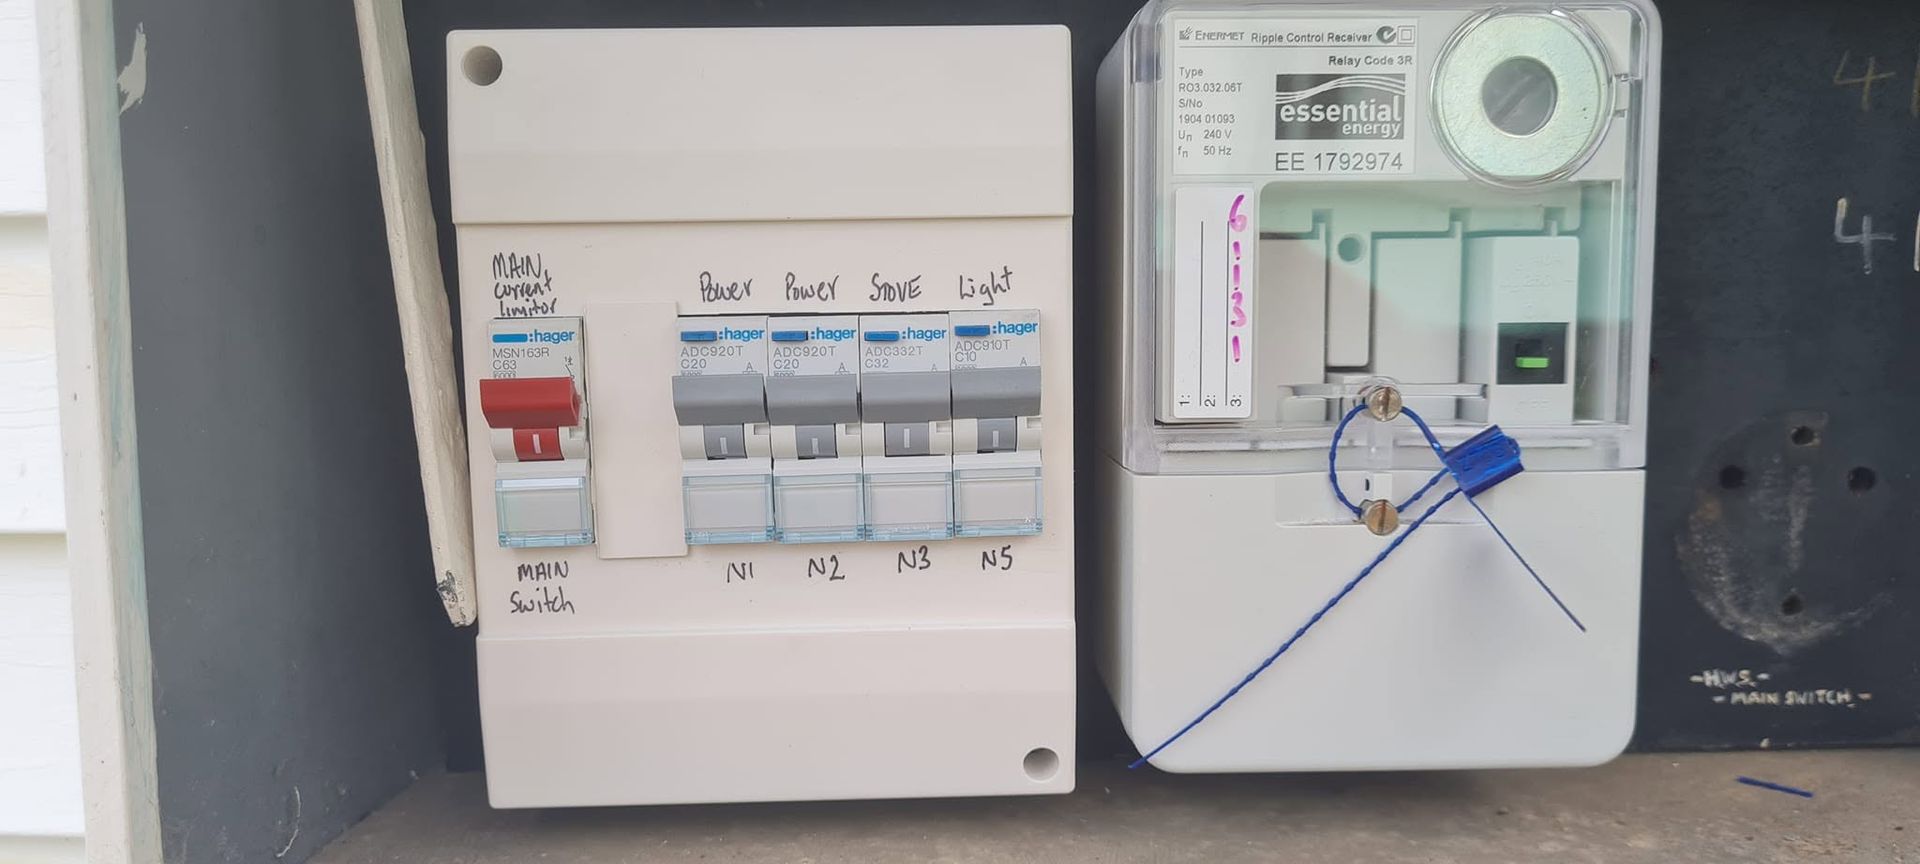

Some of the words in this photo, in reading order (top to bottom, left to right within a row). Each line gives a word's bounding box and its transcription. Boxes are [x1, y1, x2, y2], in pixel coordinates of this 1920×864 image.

[1251, 32, 1285, 43] Ripple
[1288, 32, 1324, 43] Control
[1327, 32, 1372, 43] Receiver
[1328, 55, 1361, 67] Relay
[1364, 55, 1394, 66] Code
[1397, 55, 1413, 65] 3R
[1179, 67, 1204, 78] Type
[1178, 98, 1203, 109] S/No
[1279, 95, 1402, 123] essential
[1178, 114, 1202, 124] 1904
[1204, 114, 1236, 124] 01093
[1203, 130, 1222, 140] 240
[1224, 130, 1233, 140] V
[1341, 121, 1402, 139] energy
[1203, 146, 1216, 156] 50
[1218, 147, 1232, 157] Hz
[1275, 152, 1305, 171] EE
[1313, 152, 1403, 171] 1792974
[492, 252, 541, 280] MAIN
[699, 271, 753, 303] Power
[785, 271, 840, 301] Power
[869, 272, 922, 303] STOVE
[959, 265, 1013, 306] Light
[680, 345, 744, 357] ADC920T
[773, 345, 837, 357] ADC920T
[864, 345, 924, 357] ADC332T
[954, 339, 1011, 351] ADC910T
[492, 347, 550, 358] MSN163R
[954, 351, 977, 362] C10
[492, 359, 517, 370] C63
[680, 358, 707, 369] C20
[773, 358, 800, 370] C20
[864, 358, 889, 369] C32
[897, 545, 931, 574] N3
[981, 544, 1013, 571] N5
[517, 560, 569, 582] MAIN
[808, 554, 846, 582] N2
[510, 586, 575, 614] Switch
[1730, 690, 1780, 706] MAIN
